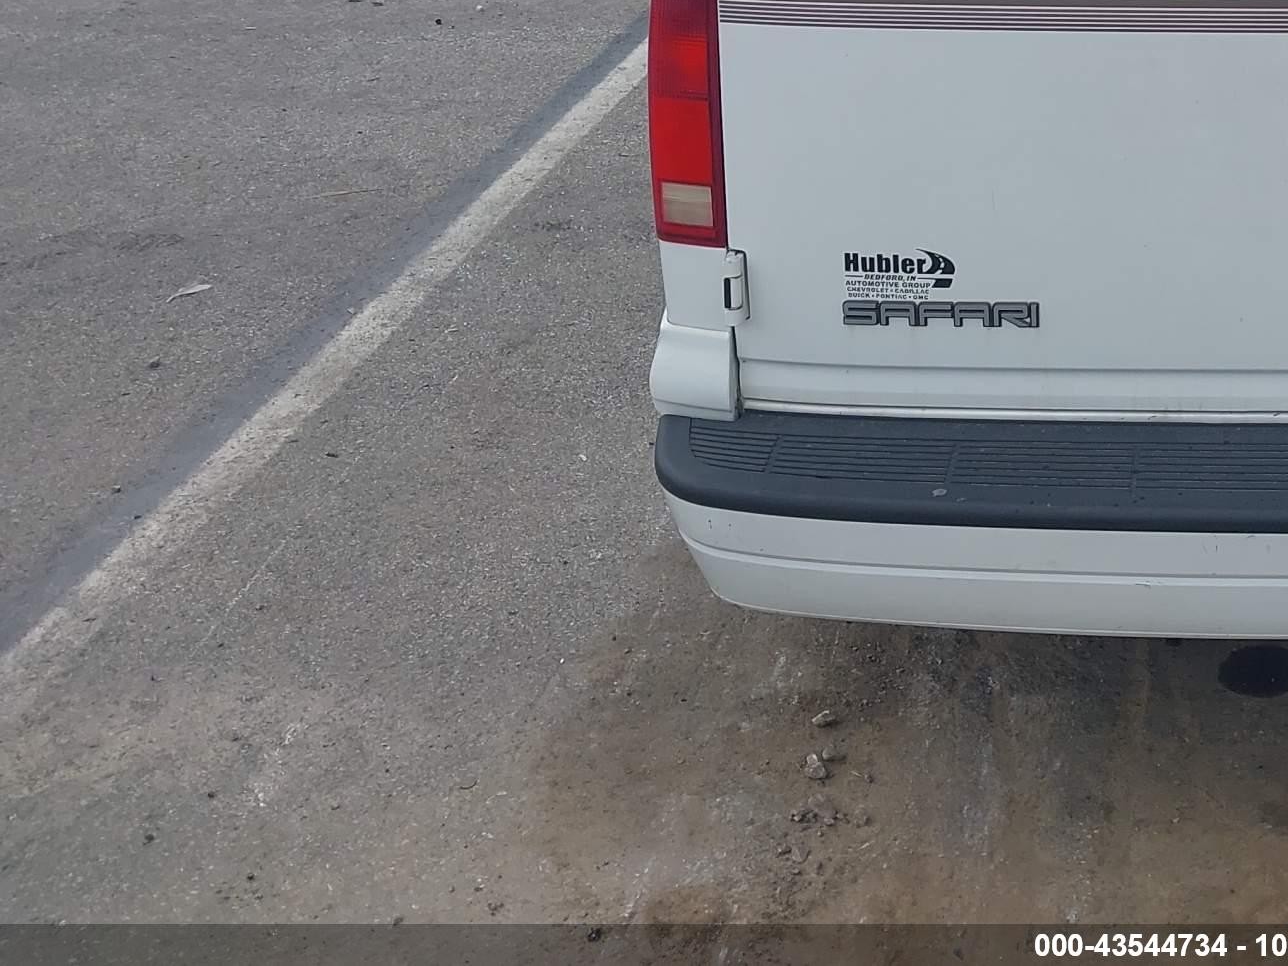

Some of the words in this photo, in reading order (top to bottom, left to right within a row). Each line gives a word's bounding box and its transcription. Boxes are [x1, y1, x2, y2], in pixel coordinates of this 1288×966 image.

[844, 252, 927, 274] Hubler
[845, 280, 899, 288] AUTOMOTIVE
[842, 300, 1040, 328] SAFARI
